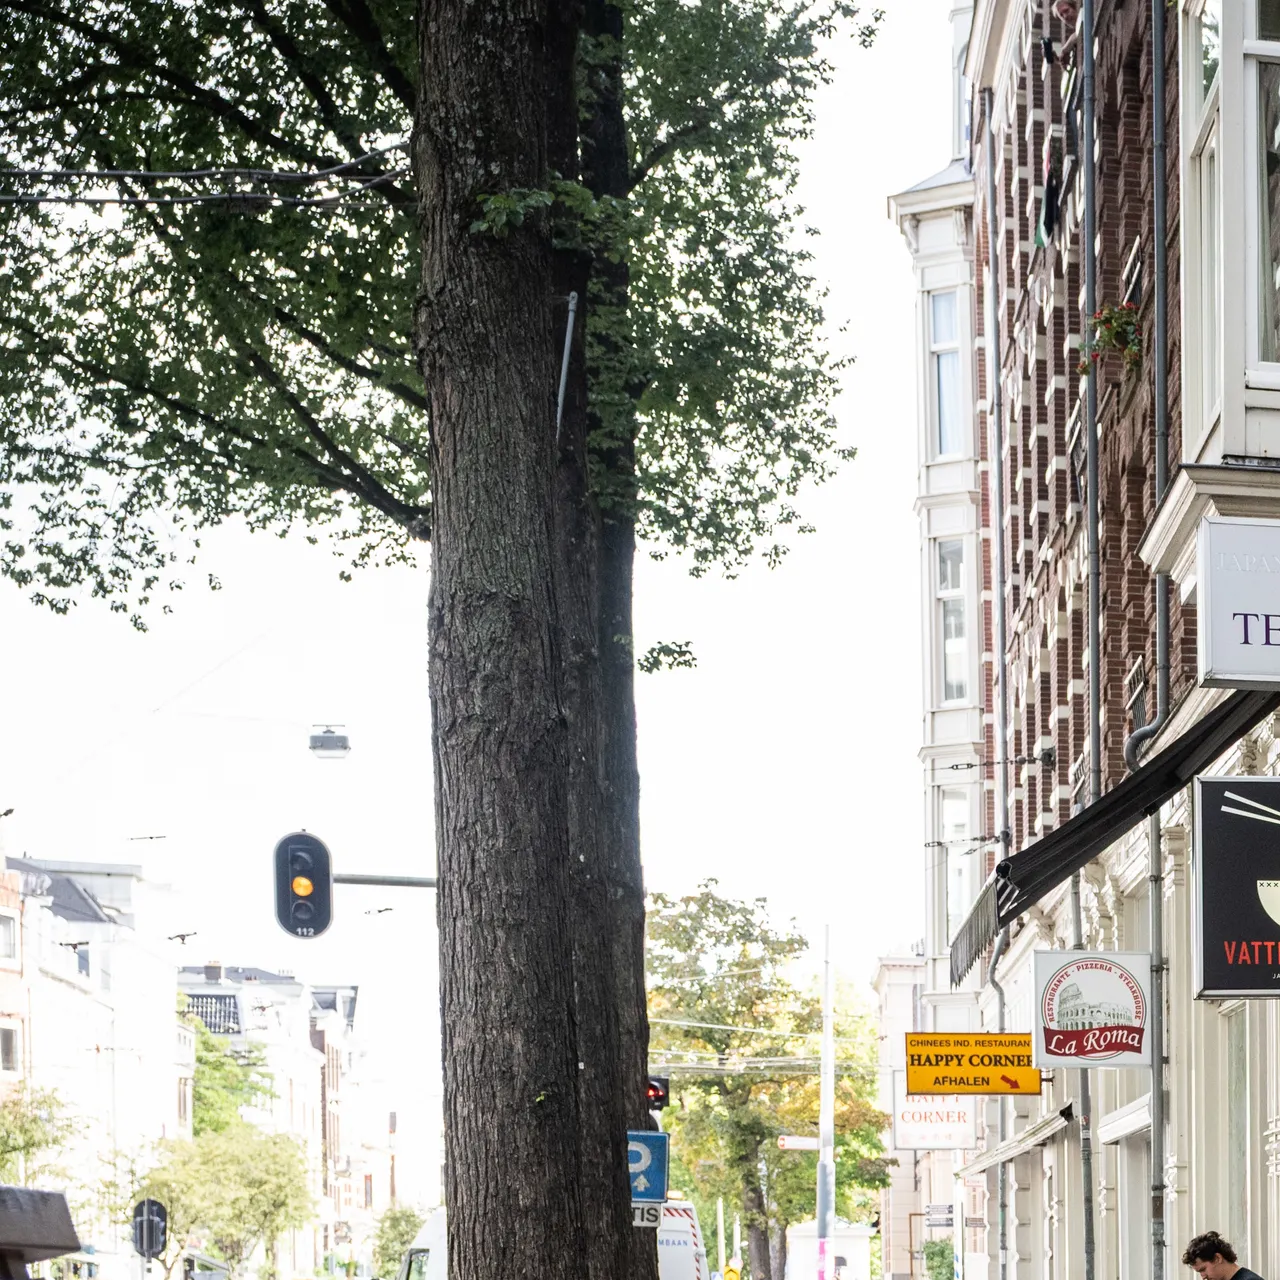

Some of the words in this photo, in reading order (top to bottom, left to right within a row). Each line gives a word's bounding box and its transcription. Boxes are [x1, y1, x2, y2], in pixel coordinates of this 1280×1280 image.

[296, 927, 315, 936] 112
[1047, 971, 1071, 1023] RESTAURANTE
[1076, 963, 1113, 973] PIZZERIA
[1118, 973, 1142, 1020] STEAKHOUSE
[910, 1039, 951, 1047] CHINEES
[1048, 1034, 1077, 1055] La
[1083, 1029, 1141, 1051] Roma
[910, 1054, 965, 1067] HAPPY
[933, 1076, 990, 1086] AFHALEN
[901, 1110, 967, 1124] CORNER
[632, 1207, 659, 1223] TIS
[658, 1239, 688, 1247] MBAAN
